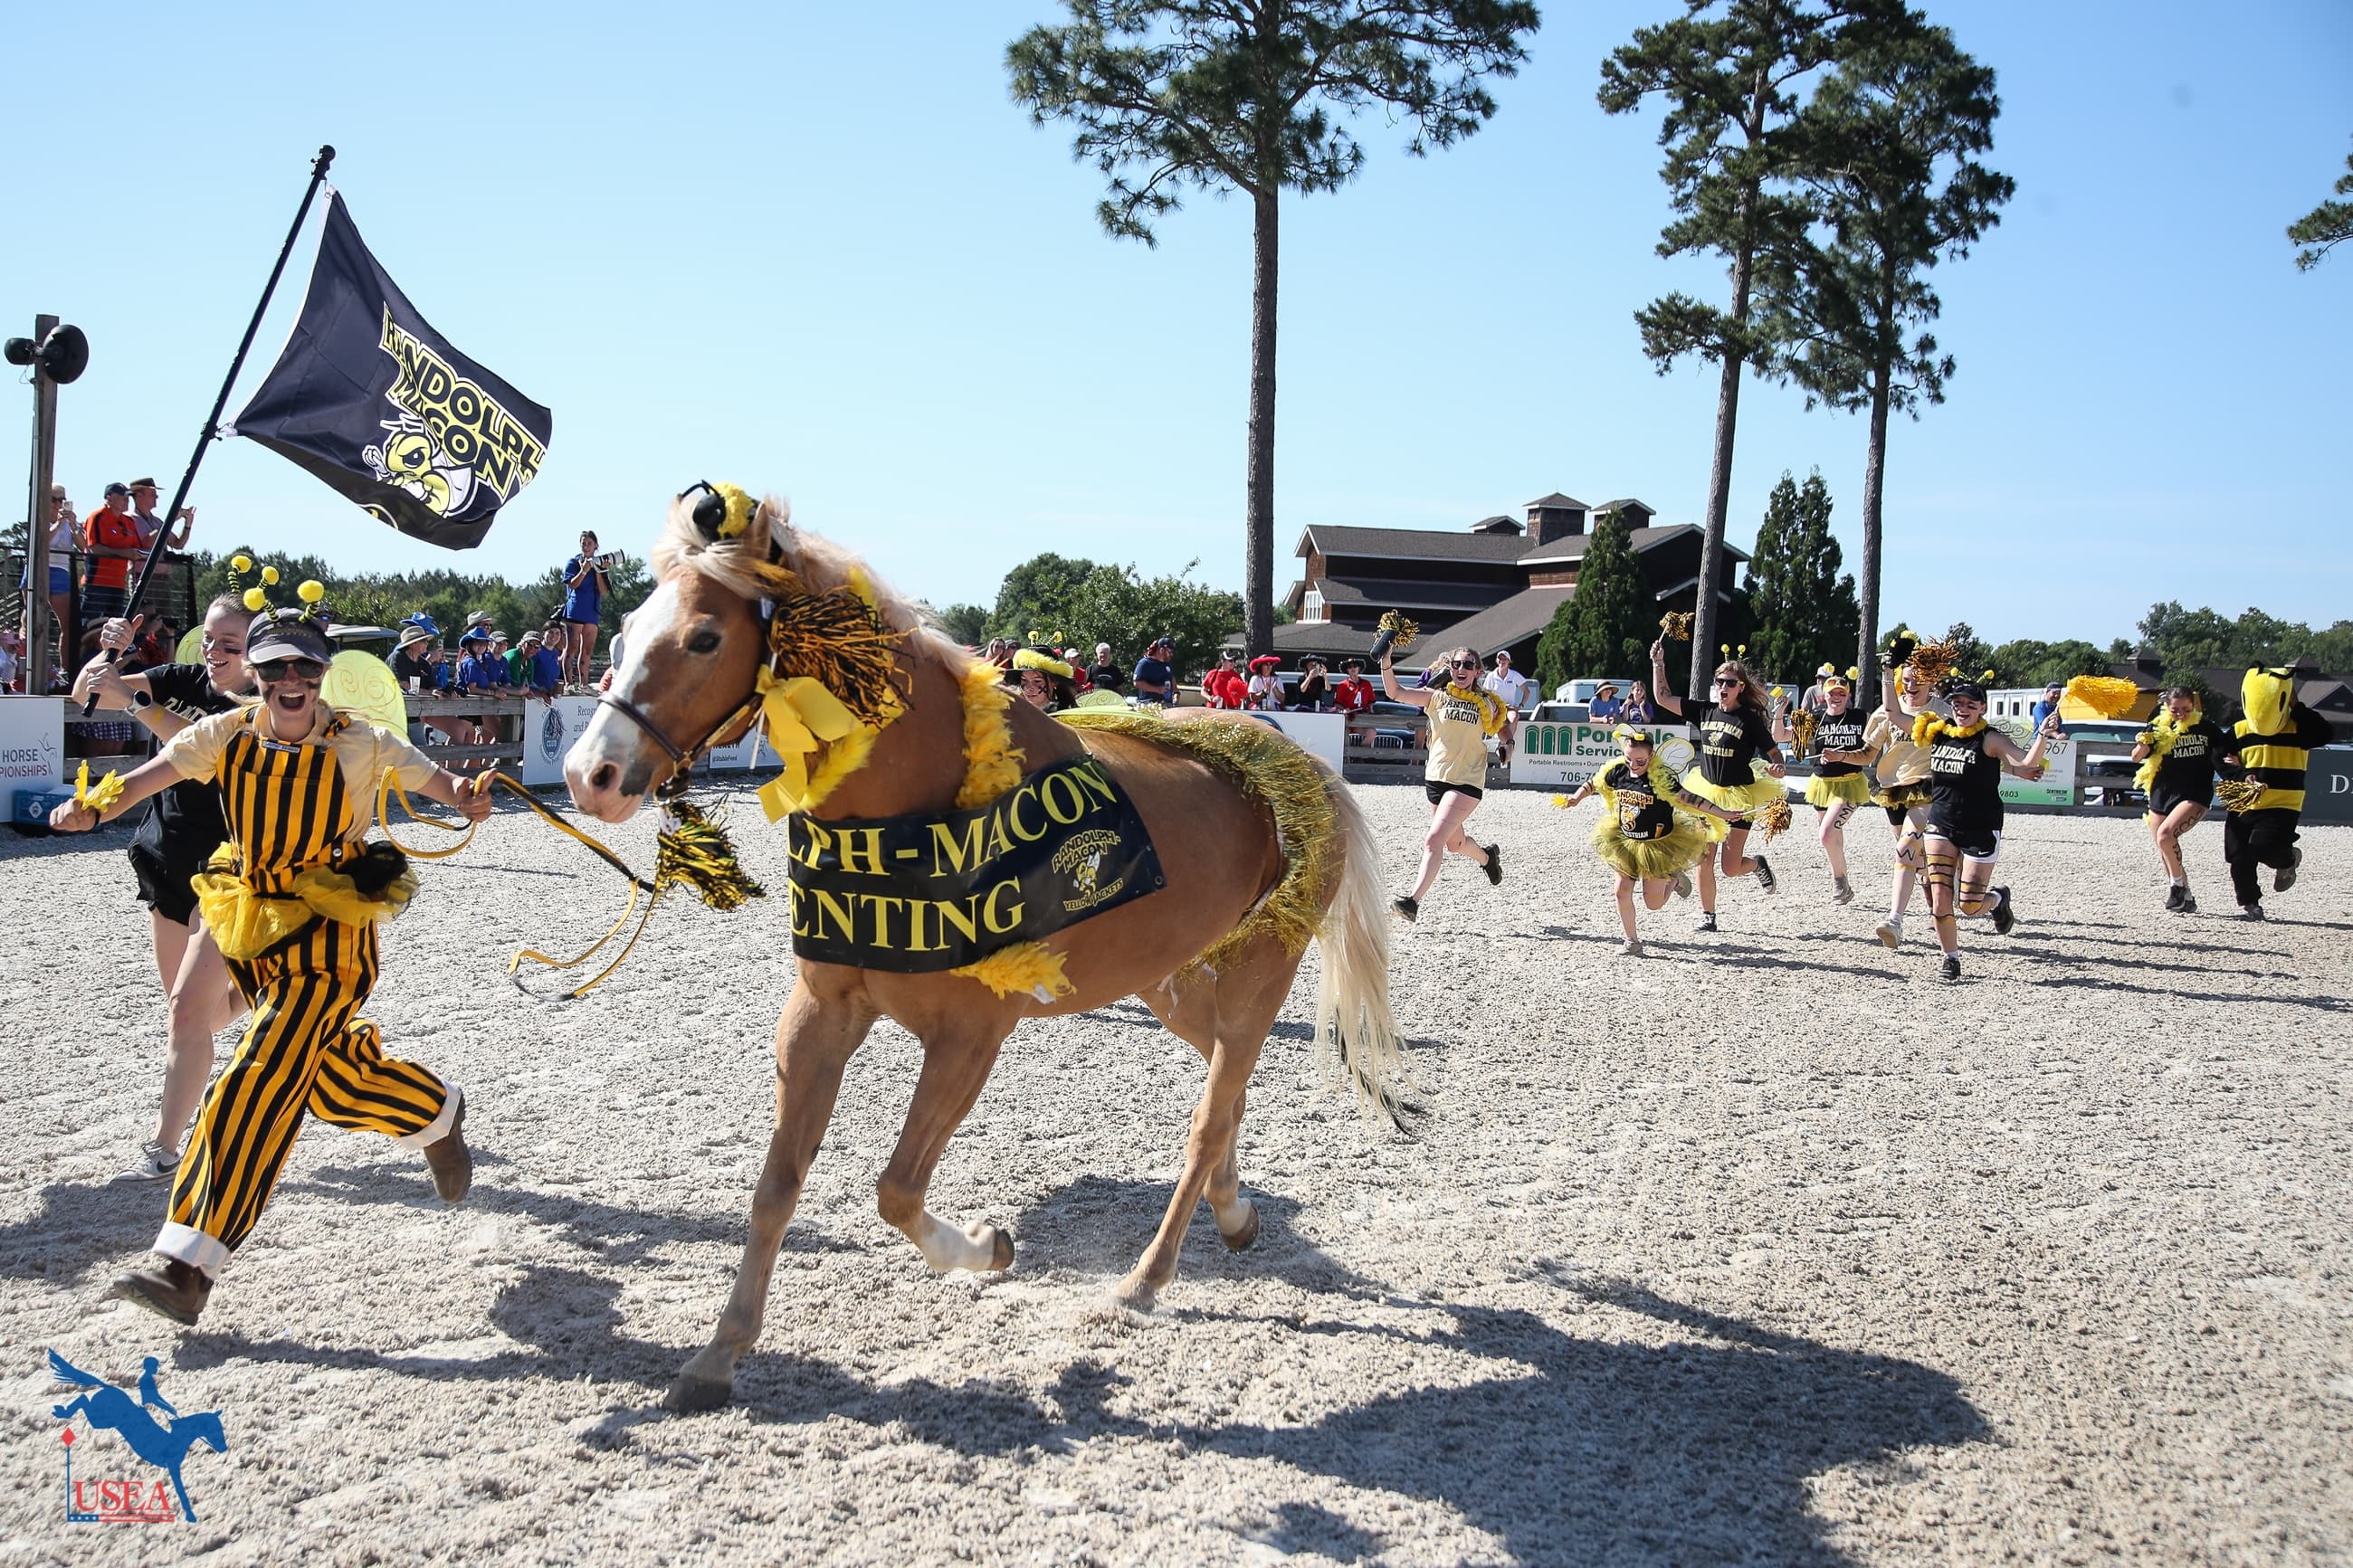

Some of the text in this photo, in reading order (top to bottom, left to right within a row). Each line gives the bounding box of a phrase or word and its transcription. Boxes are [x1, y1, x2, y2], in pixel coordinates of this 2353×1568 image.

[1354, 691, 1363, 708] 4
[1444, 708, 1480, 725] MACON
[1824, 735, 1857, 746] MACON
[2, 748, 39, 763] HORSE
[1576, 745, 1624, 756] Servic
[2173, 745, 2205, 758] MACON
[1930, 757, 1966, 775] MACON
[1062, 841, 1108, 874] MACON
